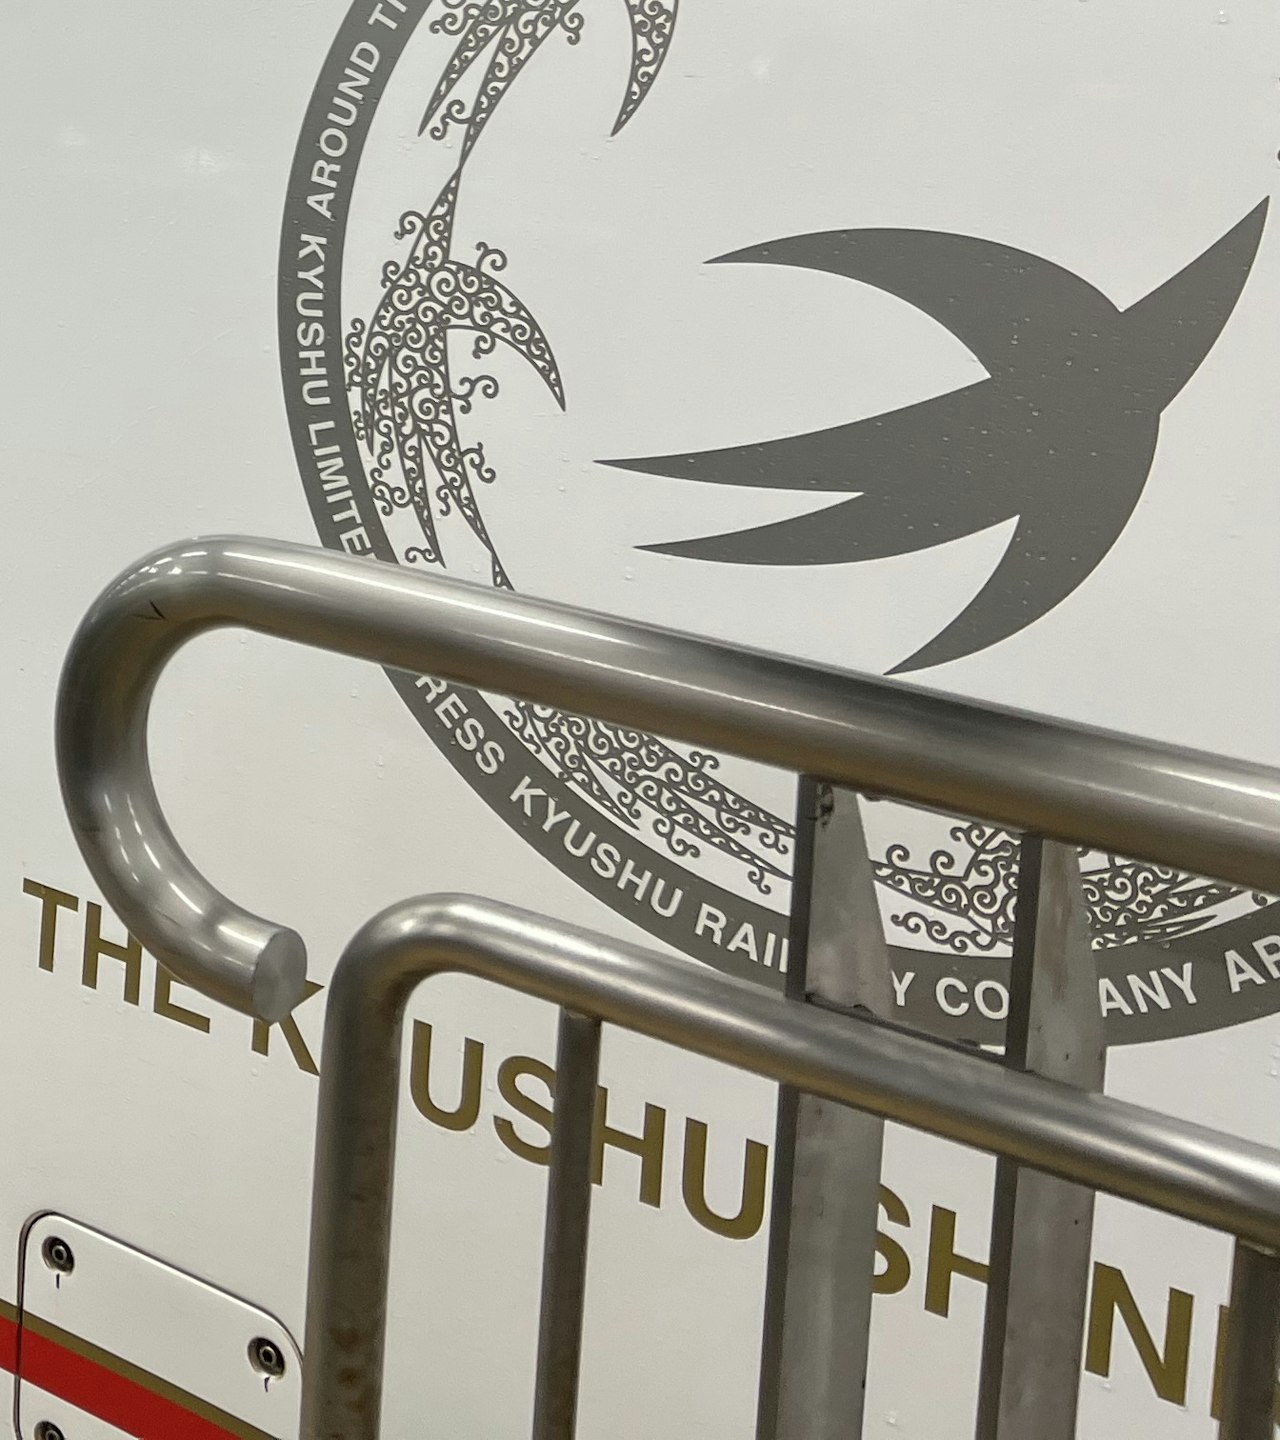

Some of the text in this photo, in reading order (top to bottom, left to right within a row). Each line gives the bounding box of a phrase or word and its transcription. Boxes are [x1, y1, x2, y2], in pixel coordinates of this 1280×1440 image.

[306, 41, 381, 220] AROUND
[295, 233, 331, 406] KYUSHU
[307, 420, 377, 560] LIMITE
[509, 776, 684, 918] KYUSHU
[936, 962, 1197, 1020] COANY
